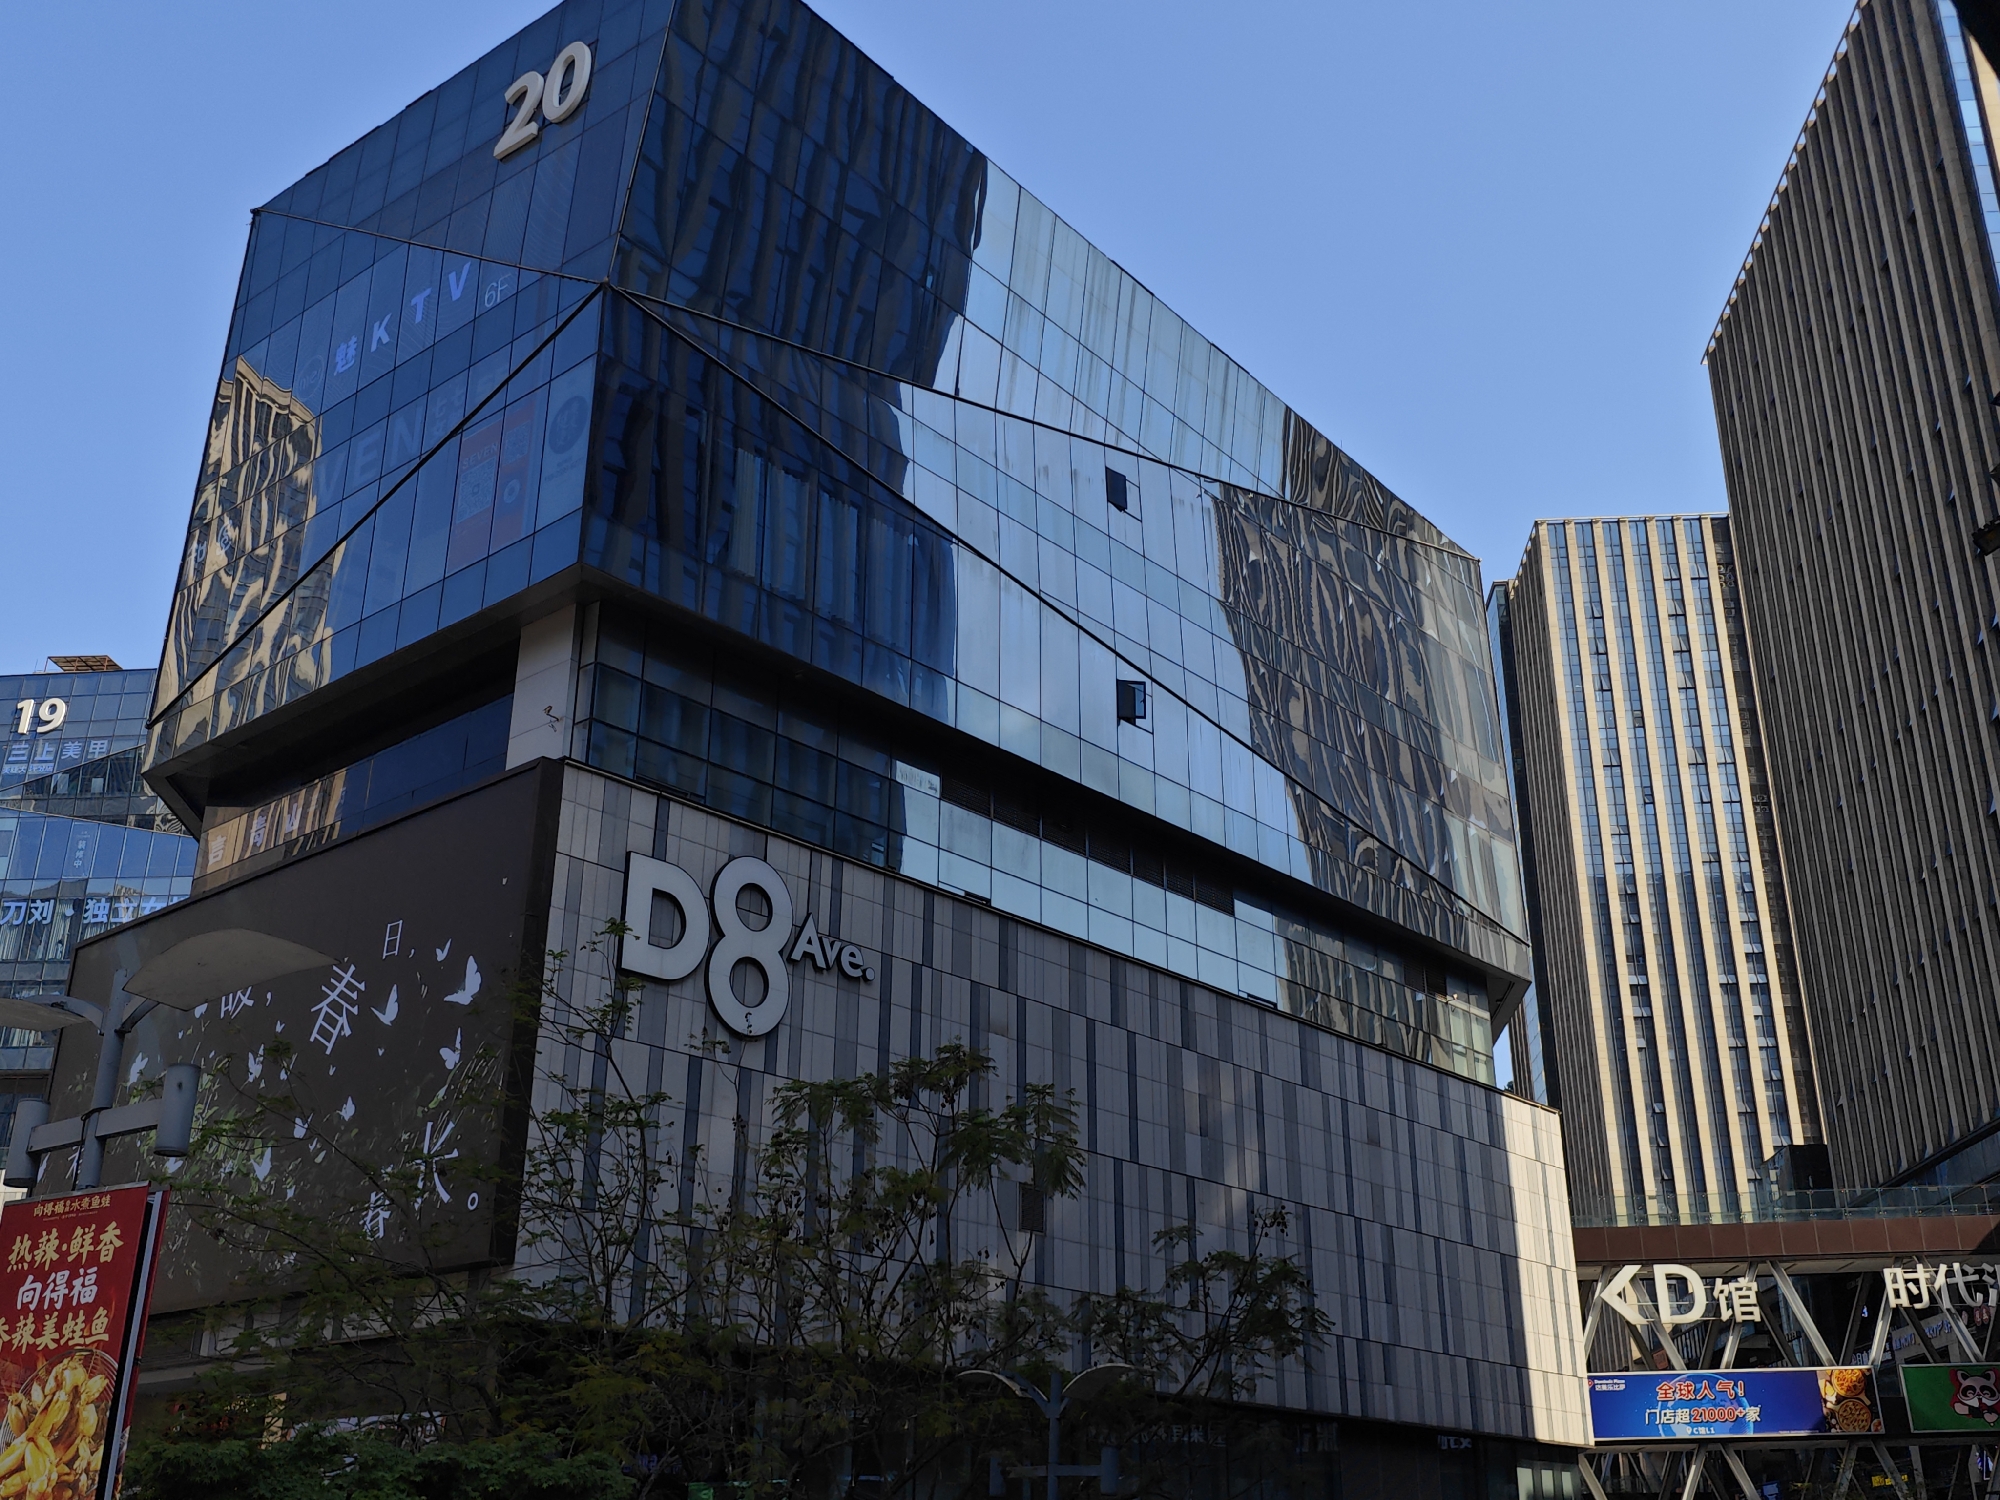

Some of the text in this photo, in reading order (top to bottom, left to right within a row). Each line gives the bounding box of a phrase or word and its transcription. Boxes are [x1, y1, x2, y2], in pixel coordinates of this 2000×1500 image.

[493, 41, 591, 159] 20
[484, 273, 512, 308] 6F
[17, 698, 67, 734] 19
[616, 850, 876, 1038] D8 Ave.
[16, 1266, 99, 1311] 向得福
